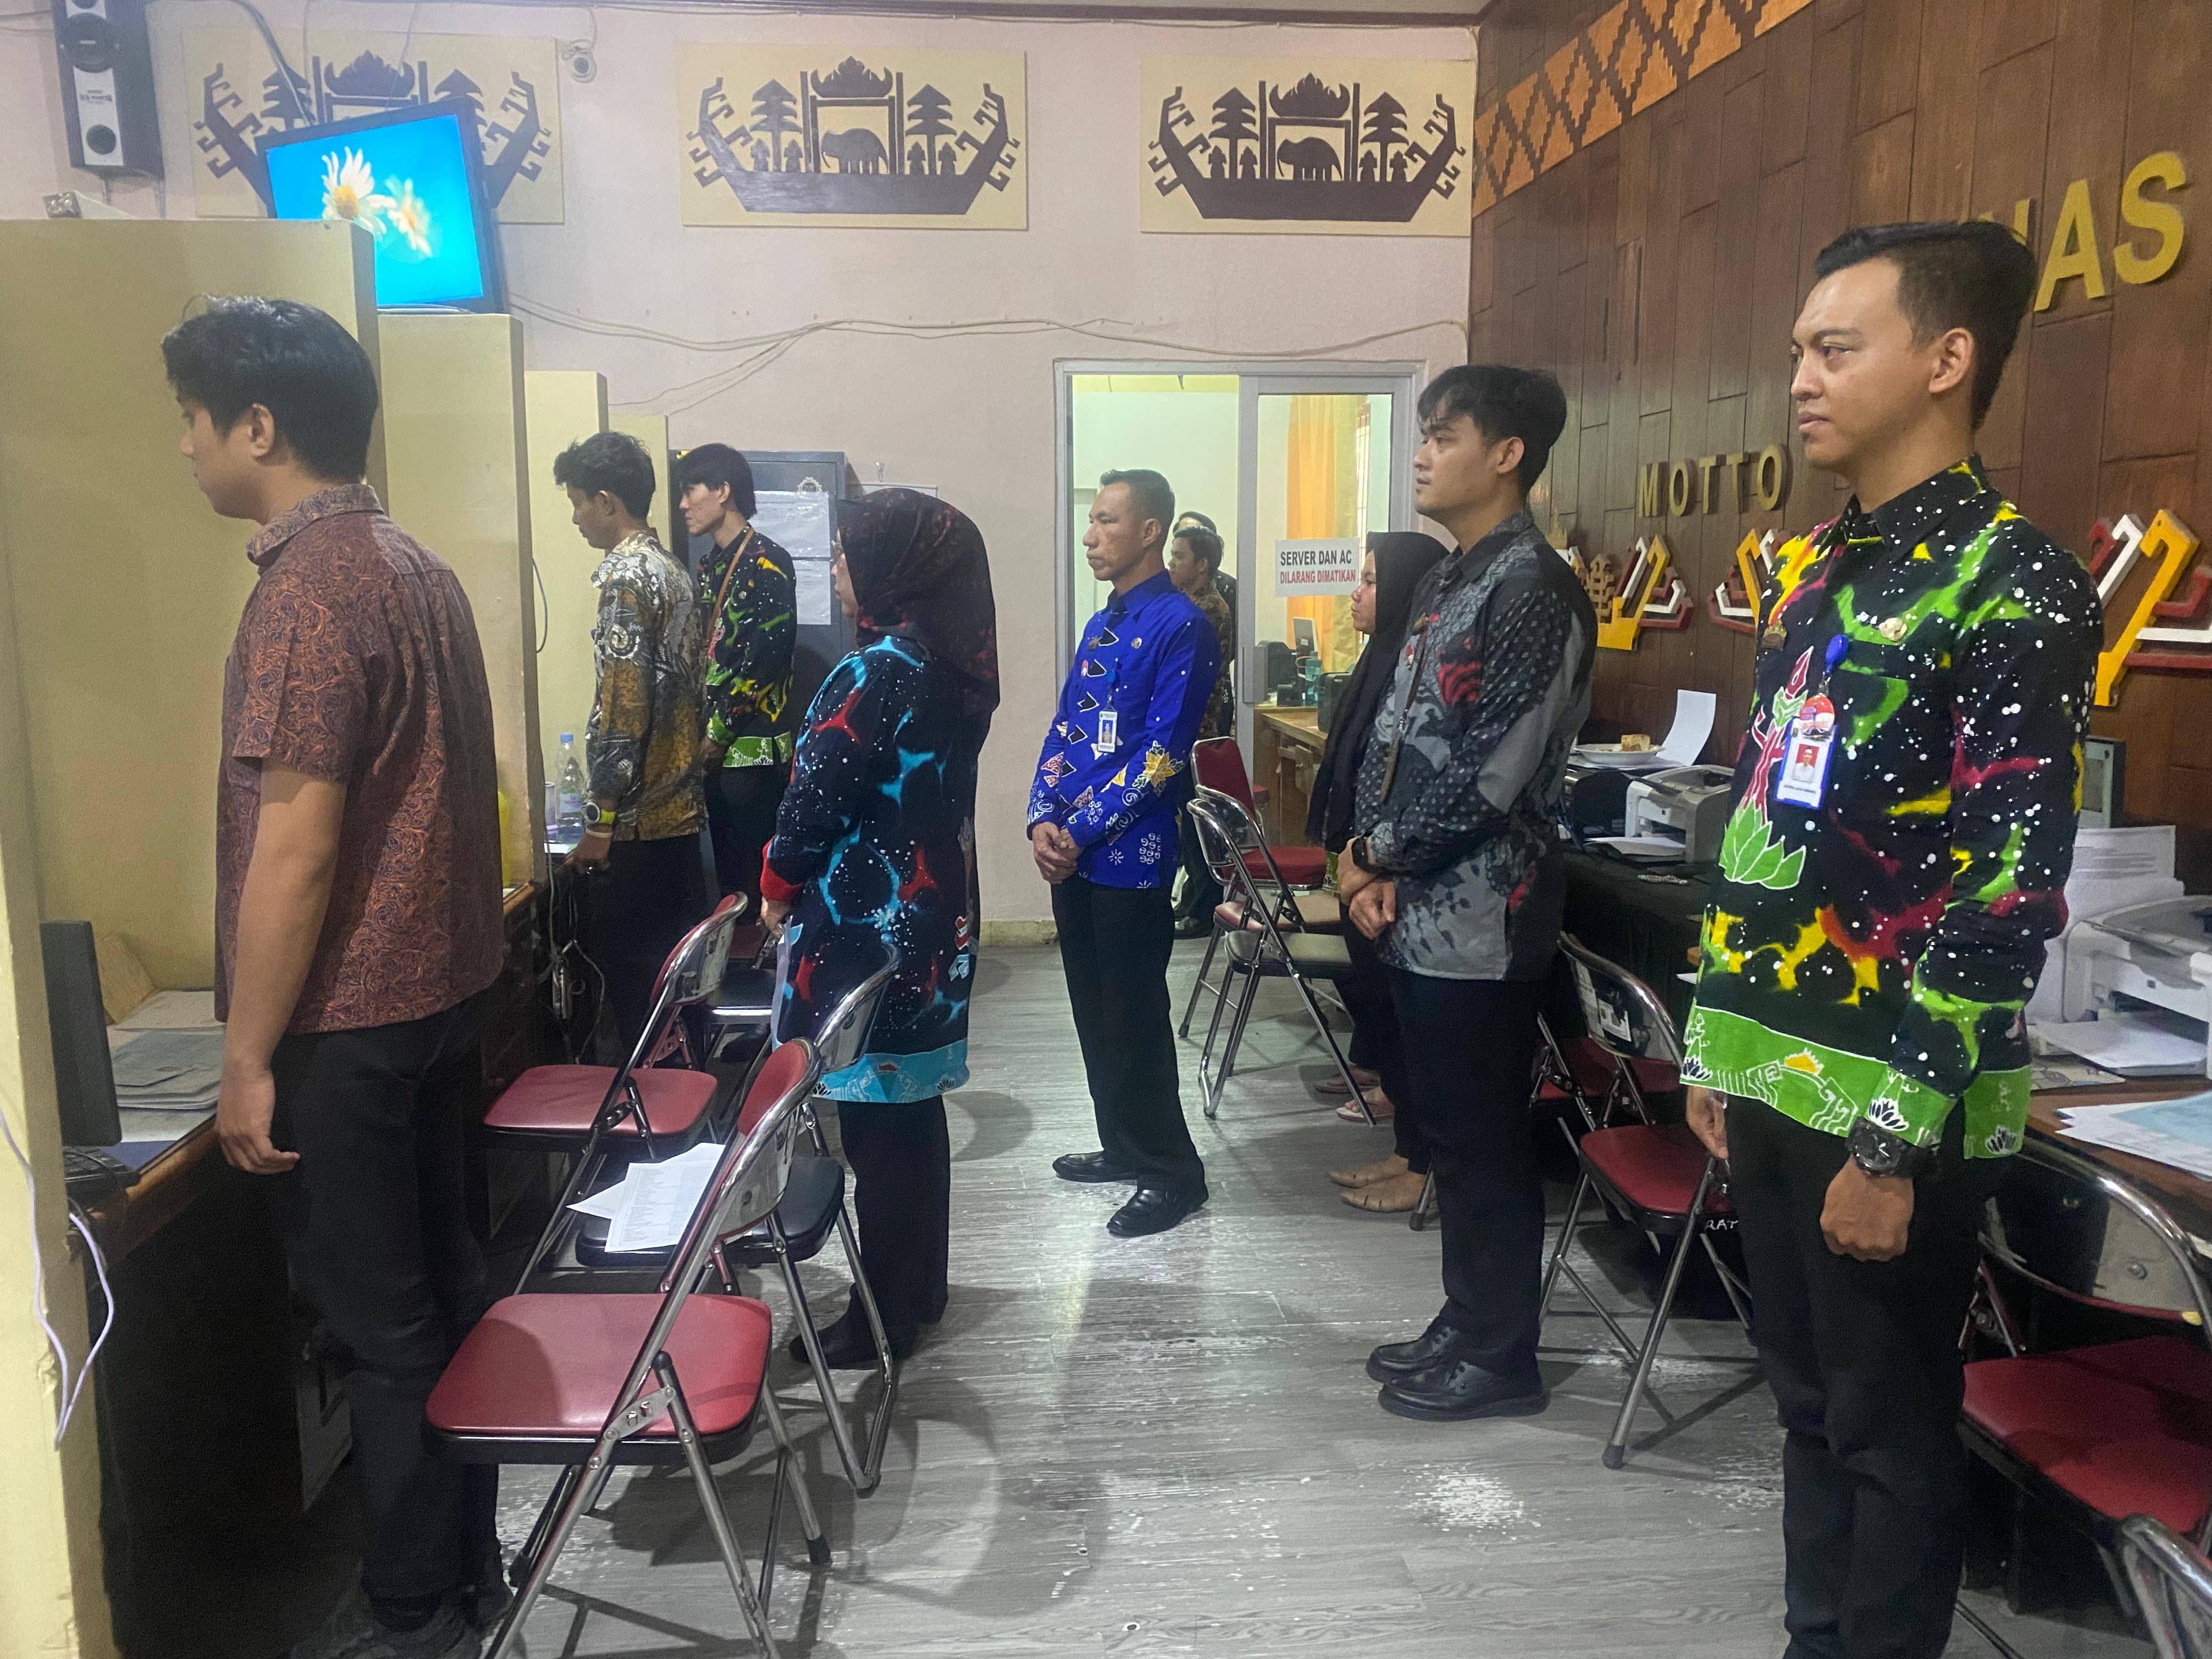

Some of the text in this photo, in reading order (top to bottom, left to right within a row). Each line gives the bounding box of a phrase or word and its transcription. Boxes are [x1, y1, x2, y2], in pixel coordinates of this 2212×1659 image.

[1637, 443, 1783, 517] MOTTO
[1280, 550, 1352, 566] SERVER DAN AC
[1280, 569, 1356, 584] DILARANG DIMATIKAN
